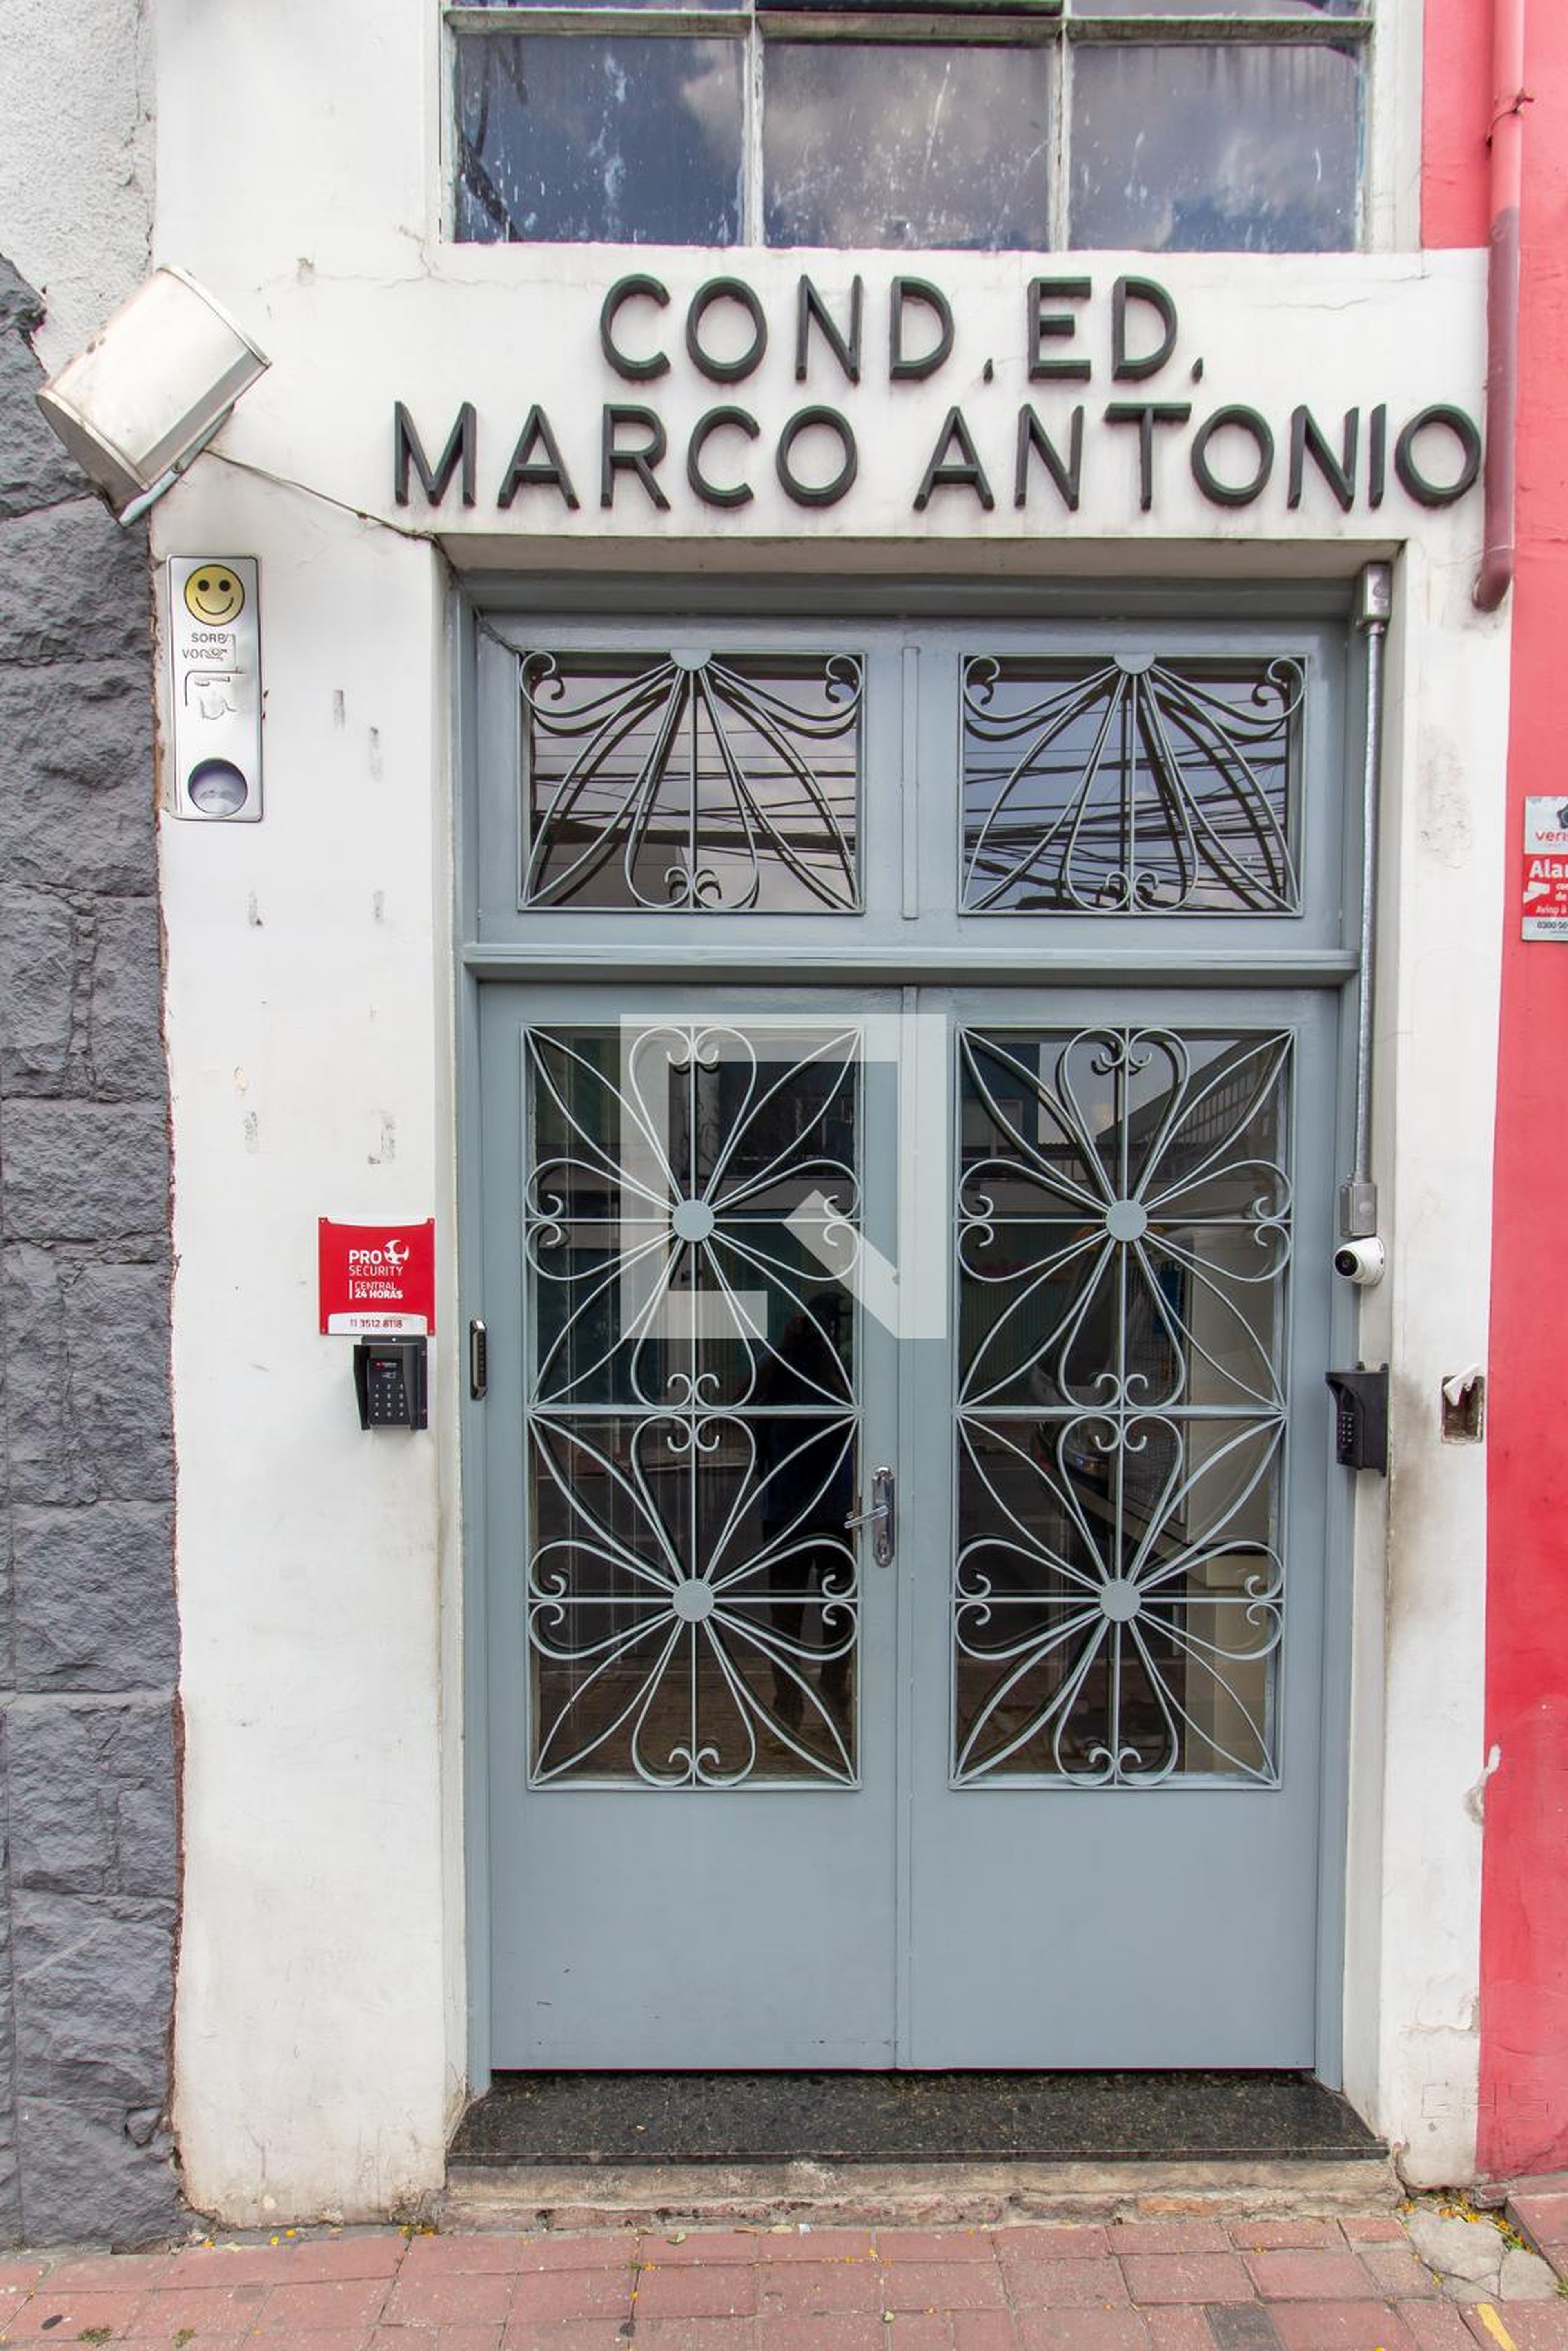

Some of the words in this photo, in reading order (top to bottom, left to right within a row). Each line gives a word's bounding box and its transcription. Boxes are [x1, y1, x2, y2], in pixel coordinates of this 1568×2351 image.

[394, 401, 858, 513] MARCO
[912, 401, 1483, 514] ANTONIO
[1535, 831, 1568, 842] veri
[349, 1250, 382, 1265] PRO
[349, 1265, 403, 1276] SECURITY
[354, 1281, 396, 1290] CENTRAL
[354, 1290, 368, 1298] 24
[369, 1290, 403, 1299] HORAS
